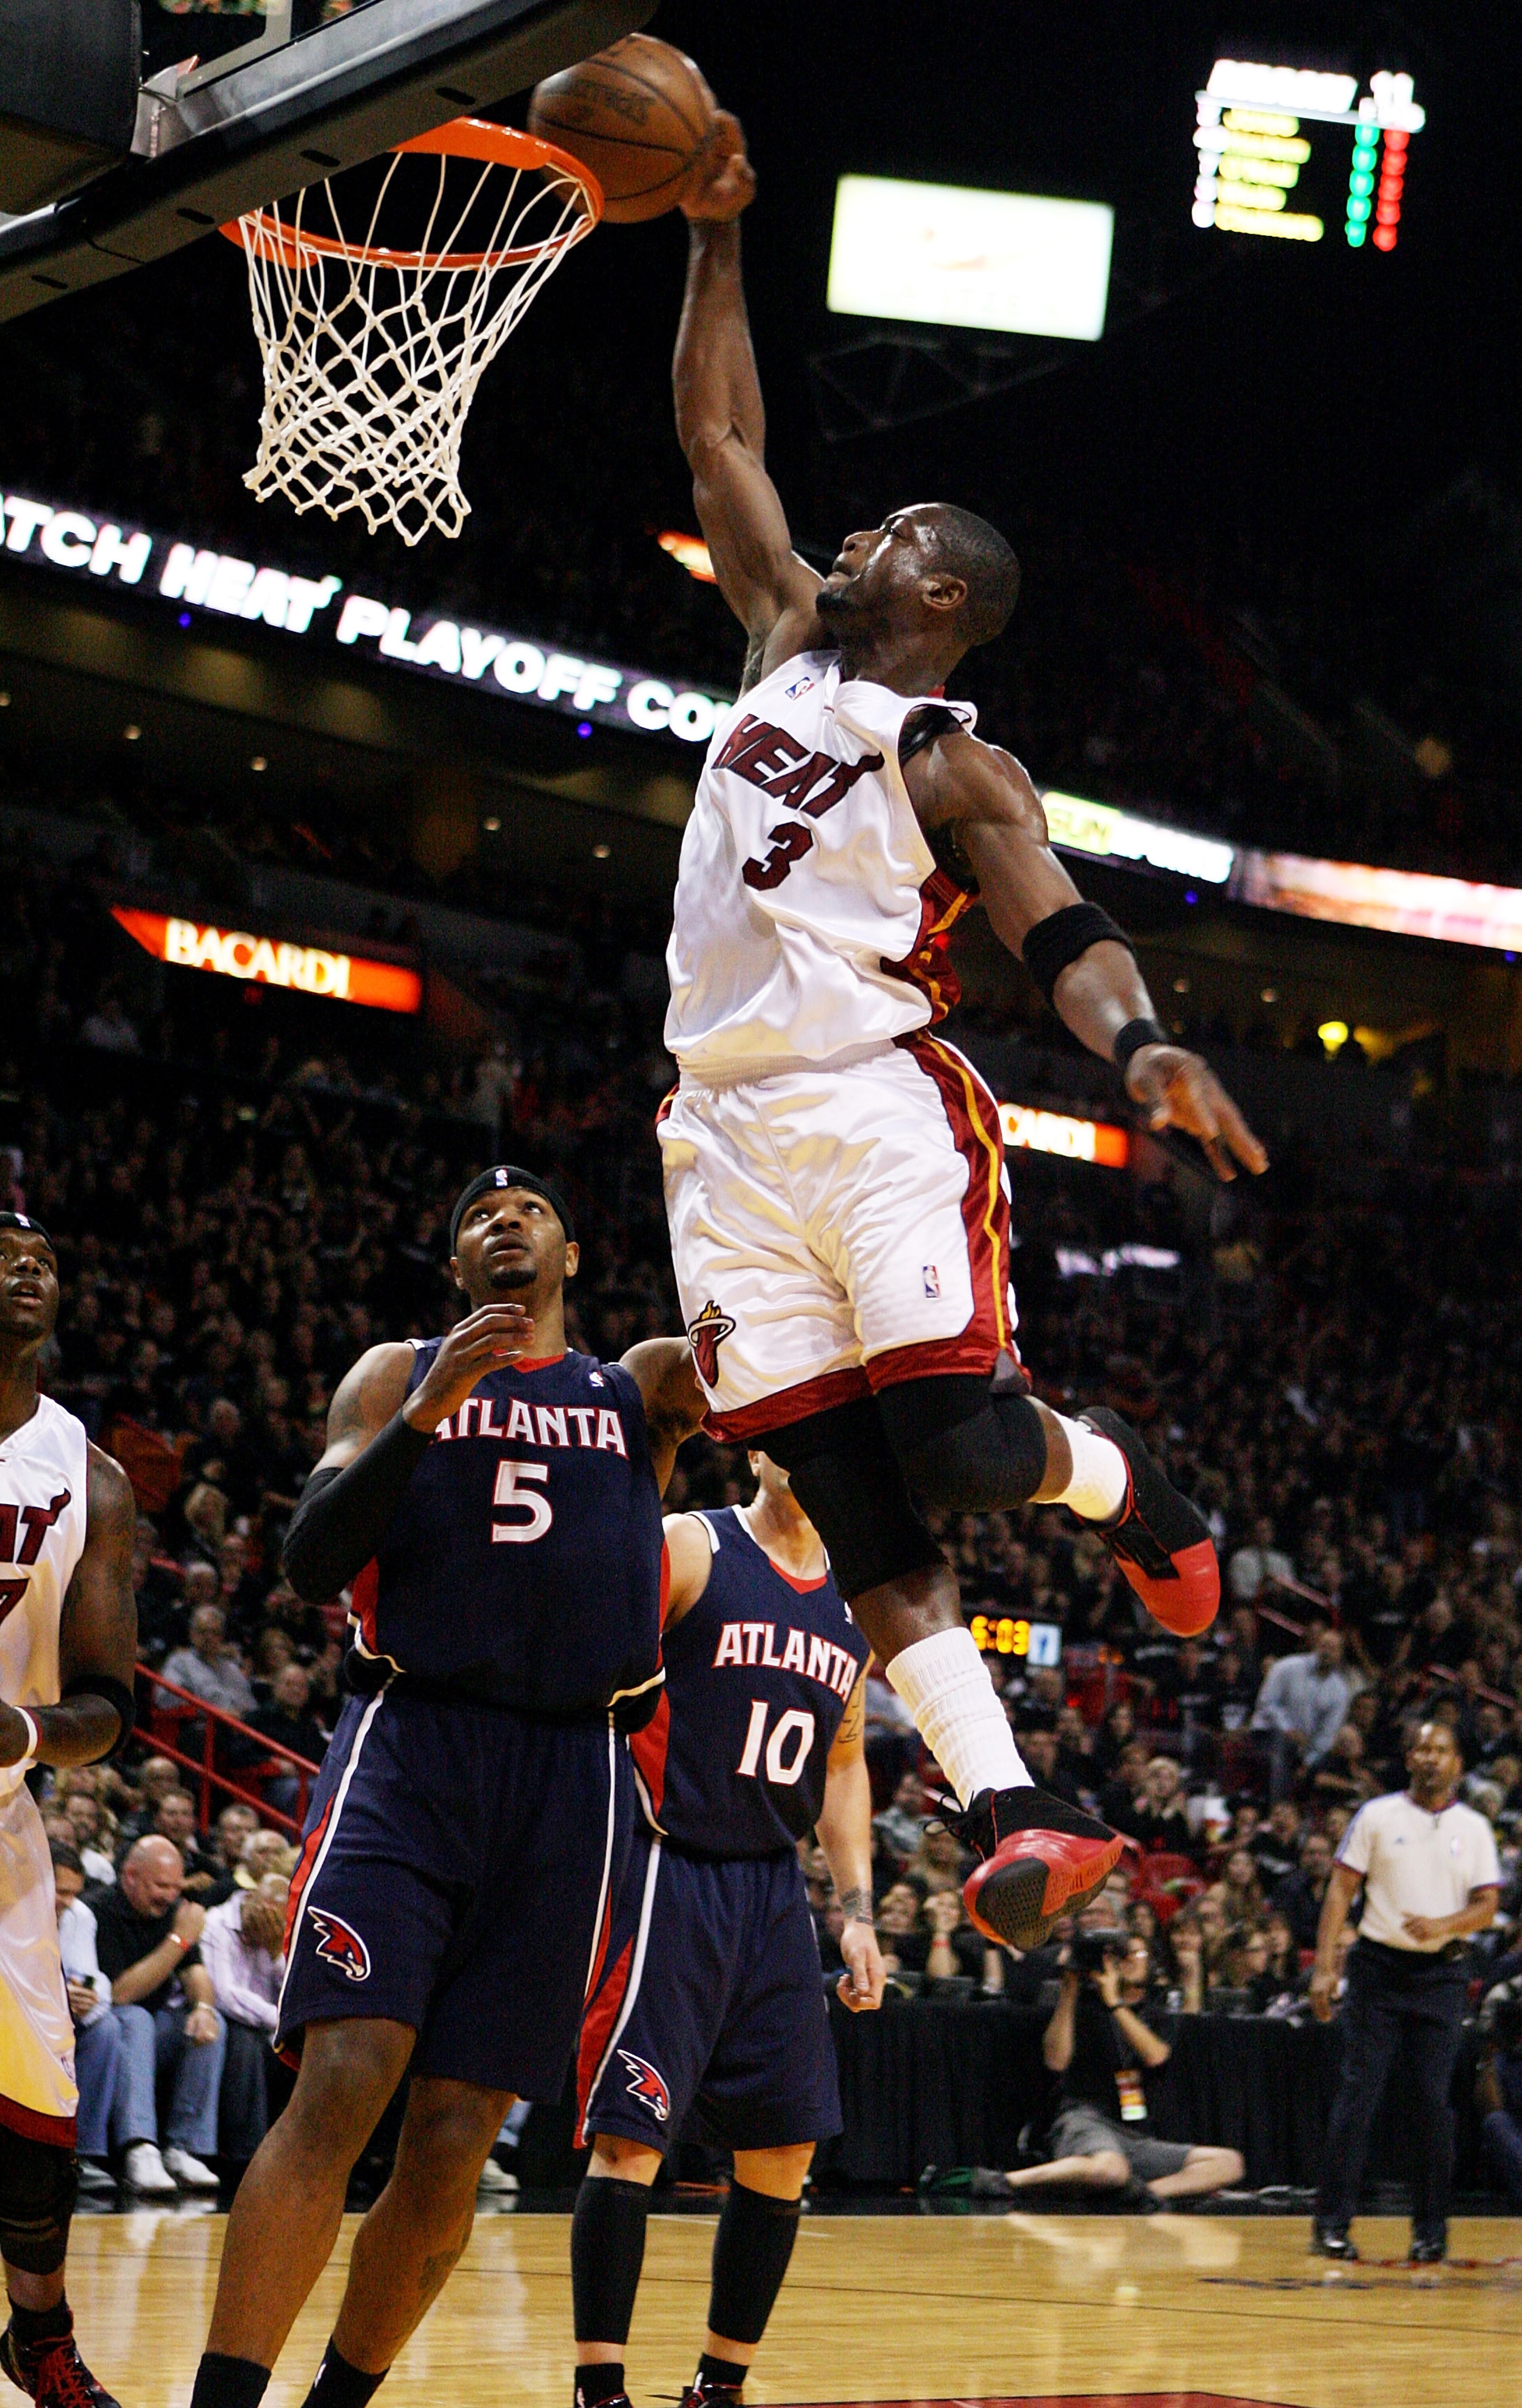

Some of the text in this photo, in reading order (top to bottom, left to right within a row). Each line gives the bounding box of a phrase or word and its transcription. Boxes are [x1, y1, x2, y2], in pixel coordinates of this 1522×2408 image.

[0, 492, 152, 584] TCH
[160, 542, 343, 634] HEAT
[336, 594, 623, 711] PLAYOFF
[711, 714, 885, 819] HEAT
[742, 821, 814, 891] 3
[165, 917, 351, 999] BACARDI
[491, 1458, 553, 1544] 5
[712, 1621, 859, 1704] ATLANTA
[735, 1699, 815, 1786] 10
